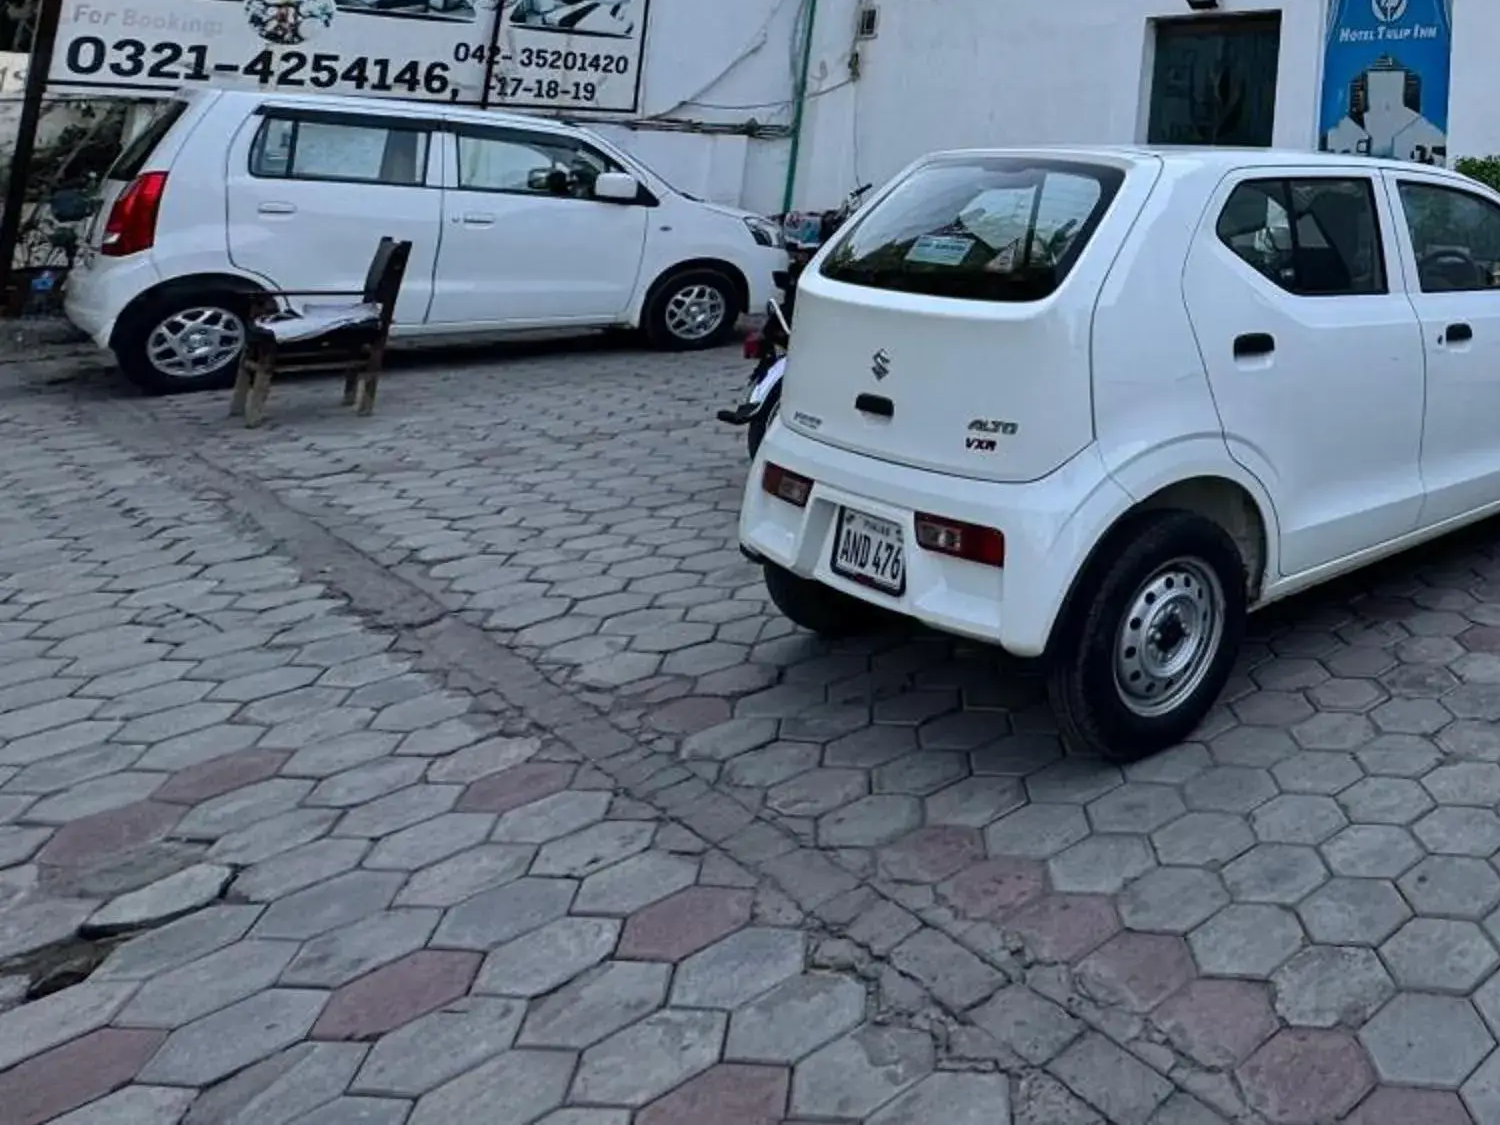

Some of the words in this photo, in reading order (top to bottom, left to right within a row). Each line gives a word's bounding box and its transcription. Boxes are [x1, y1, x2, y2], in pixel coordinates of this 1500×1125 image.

[73, 4, 118, 25] For
[519, 48, 629, 74] 35201420
[967, 418, 1019, 435] ALTO
[965, 437, 998, 451] VXR
[839, 528, 871, 568] AND
[872, 540, 903, 579] 476
